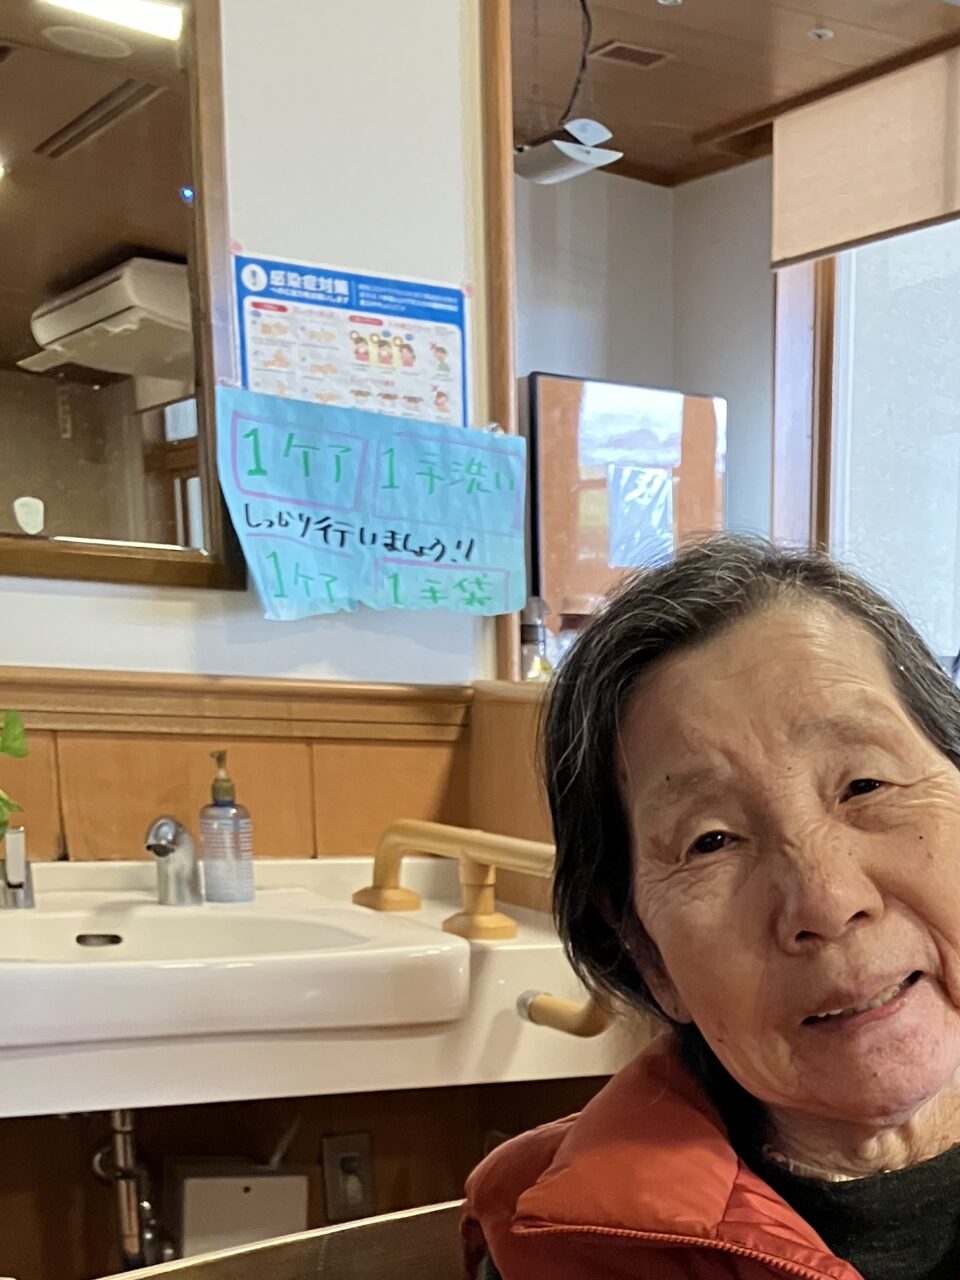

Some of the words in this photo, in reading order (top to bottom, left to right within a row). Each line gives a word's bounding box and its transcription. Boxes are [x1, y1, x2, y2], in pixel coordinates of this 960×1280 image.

[270, 270, 350, 295] 感染症対策
